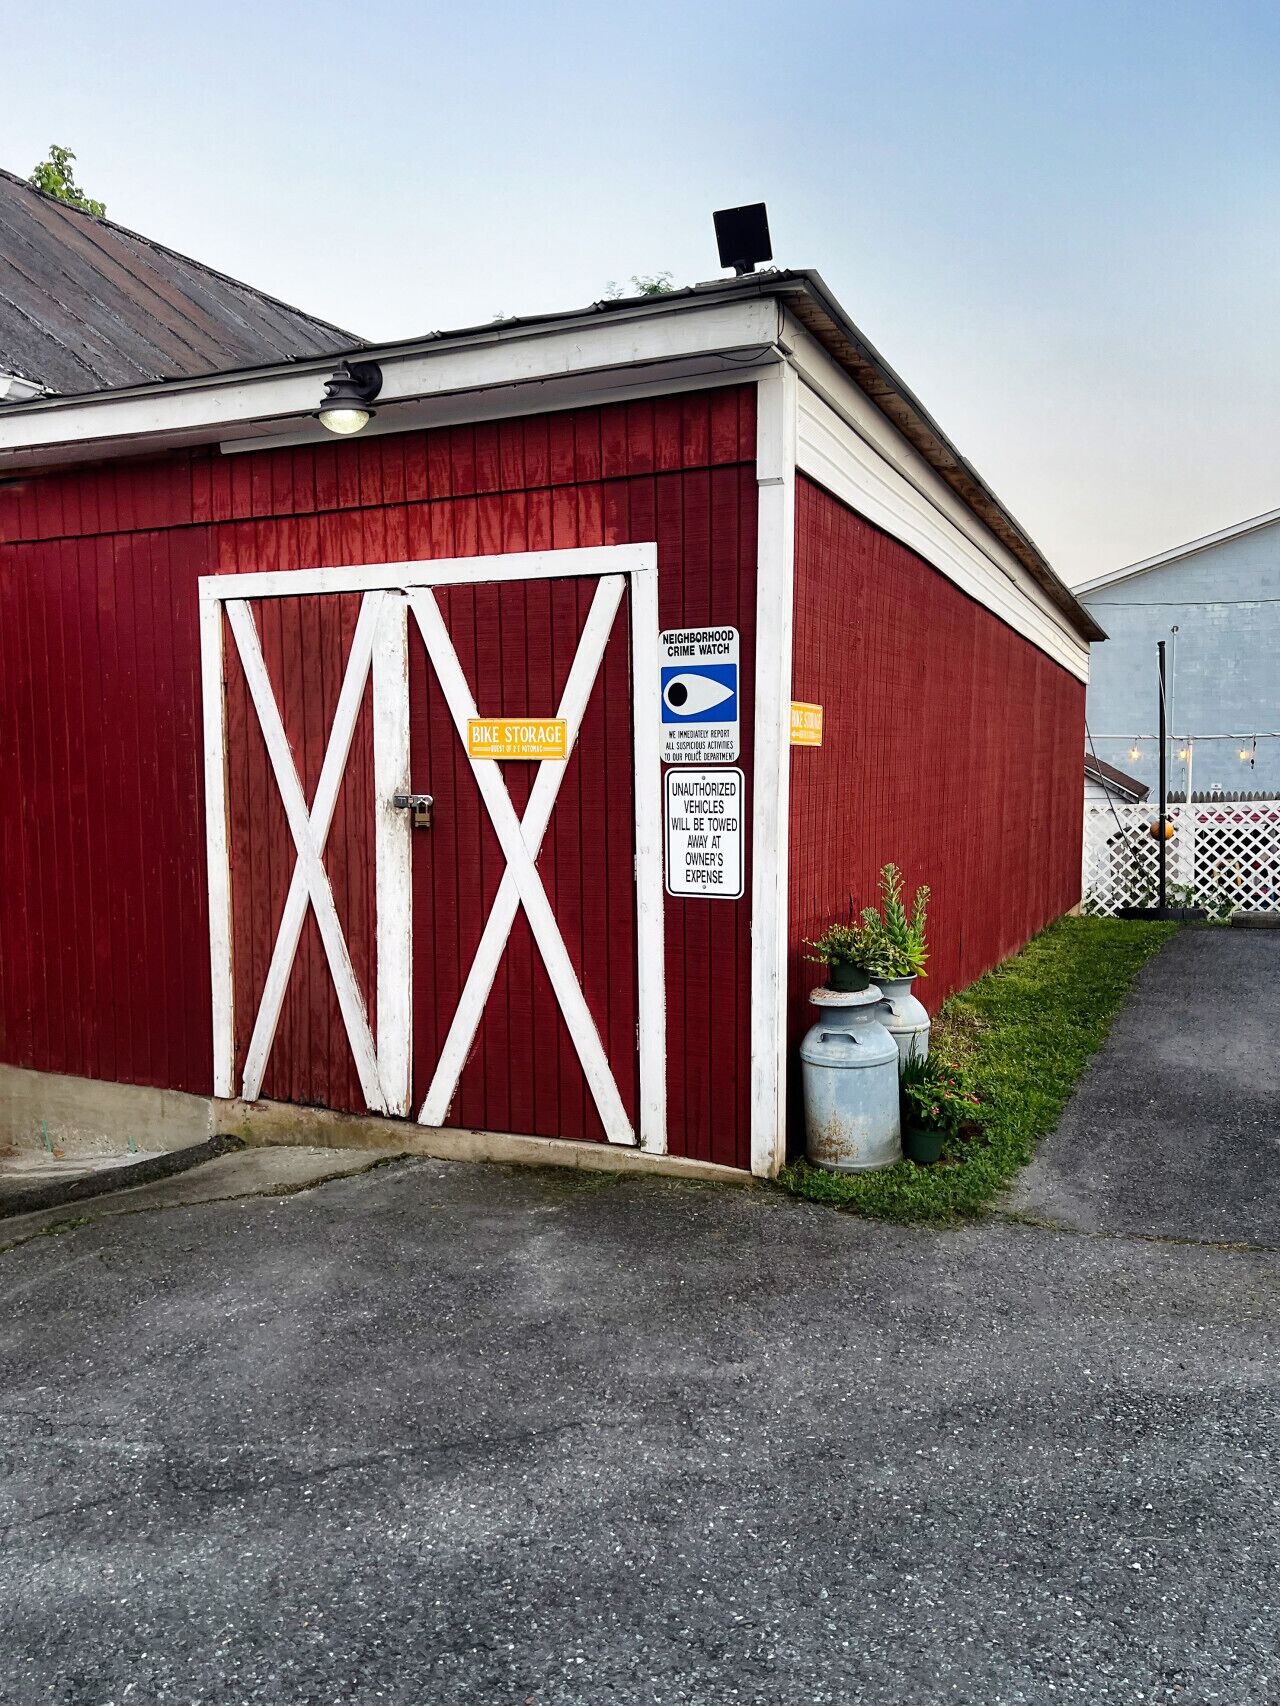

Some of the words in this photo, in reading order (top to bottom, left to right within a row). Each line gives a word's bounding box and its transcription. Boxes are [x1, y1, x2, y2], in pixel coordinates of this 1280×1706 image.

[663, 631, 734, 644] NEIGHBORHOOD
[667, 645, 695, 657] CRIME
[699, 643, 730, 655] WATCH
[473, 726, 499, 742] BIKE
[505, 726, 562, 742] STORAGE
[677, 730, 708, 738] IMMEDIATELY
[710, 729, 730, 738] REPORT
[665, 742, 674, 750] ALL
[676, 741, 706, 750] SUSPICIOUS
[707, 741, 734, 749] ACTIVITIES
[664, 753, 671, 761] TO
[672, 753, 683, 761] OUR
[684, 752, 702, 761] POLICE
[703, 752, 735, 761] DEPARTMENT
[672, 782, 737, 797] UNAUTHORIZED
[684, 800, 724, 814] VEHICLES
[671, 817, 690, 831] WILL
[693, 817, 705, 831] BE
[708, 817, 738, 832] TOWED
[687, 834, 709, 849] AWAY
[711, 835, 722, 849] AT
[685, 851, 724, 867] OWNER'S
[685, 869, 724, 884] EXPENSE
